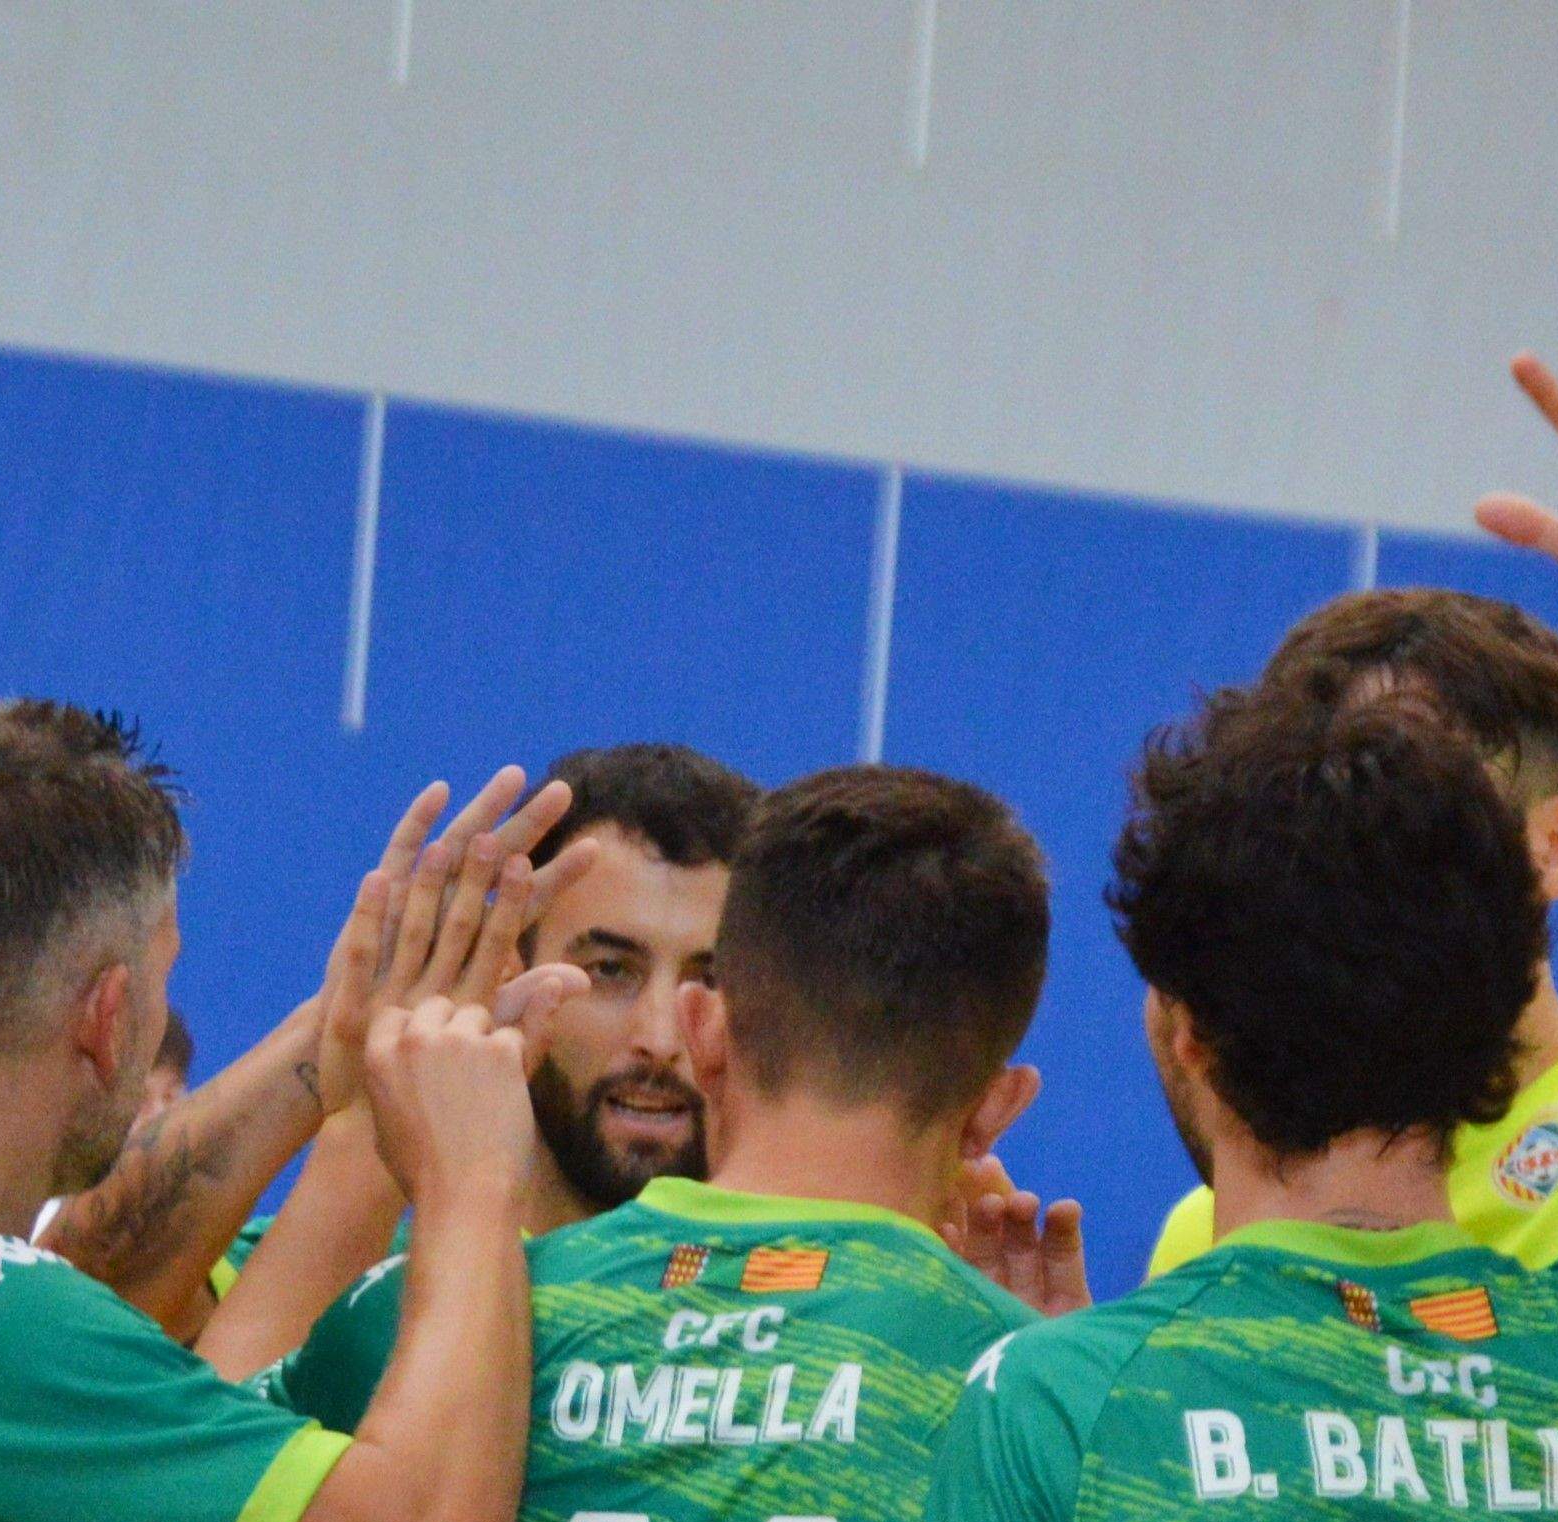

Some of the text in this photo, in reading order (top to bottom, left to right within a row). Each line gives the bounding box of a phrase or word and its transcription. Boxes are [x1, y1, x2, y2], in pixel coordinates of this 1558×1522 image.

[663, 1306, 788, 1352] CFC
[551, 1361, 863, 1448] OMELLA
[1184, 1407, 1279, 1500] B.
